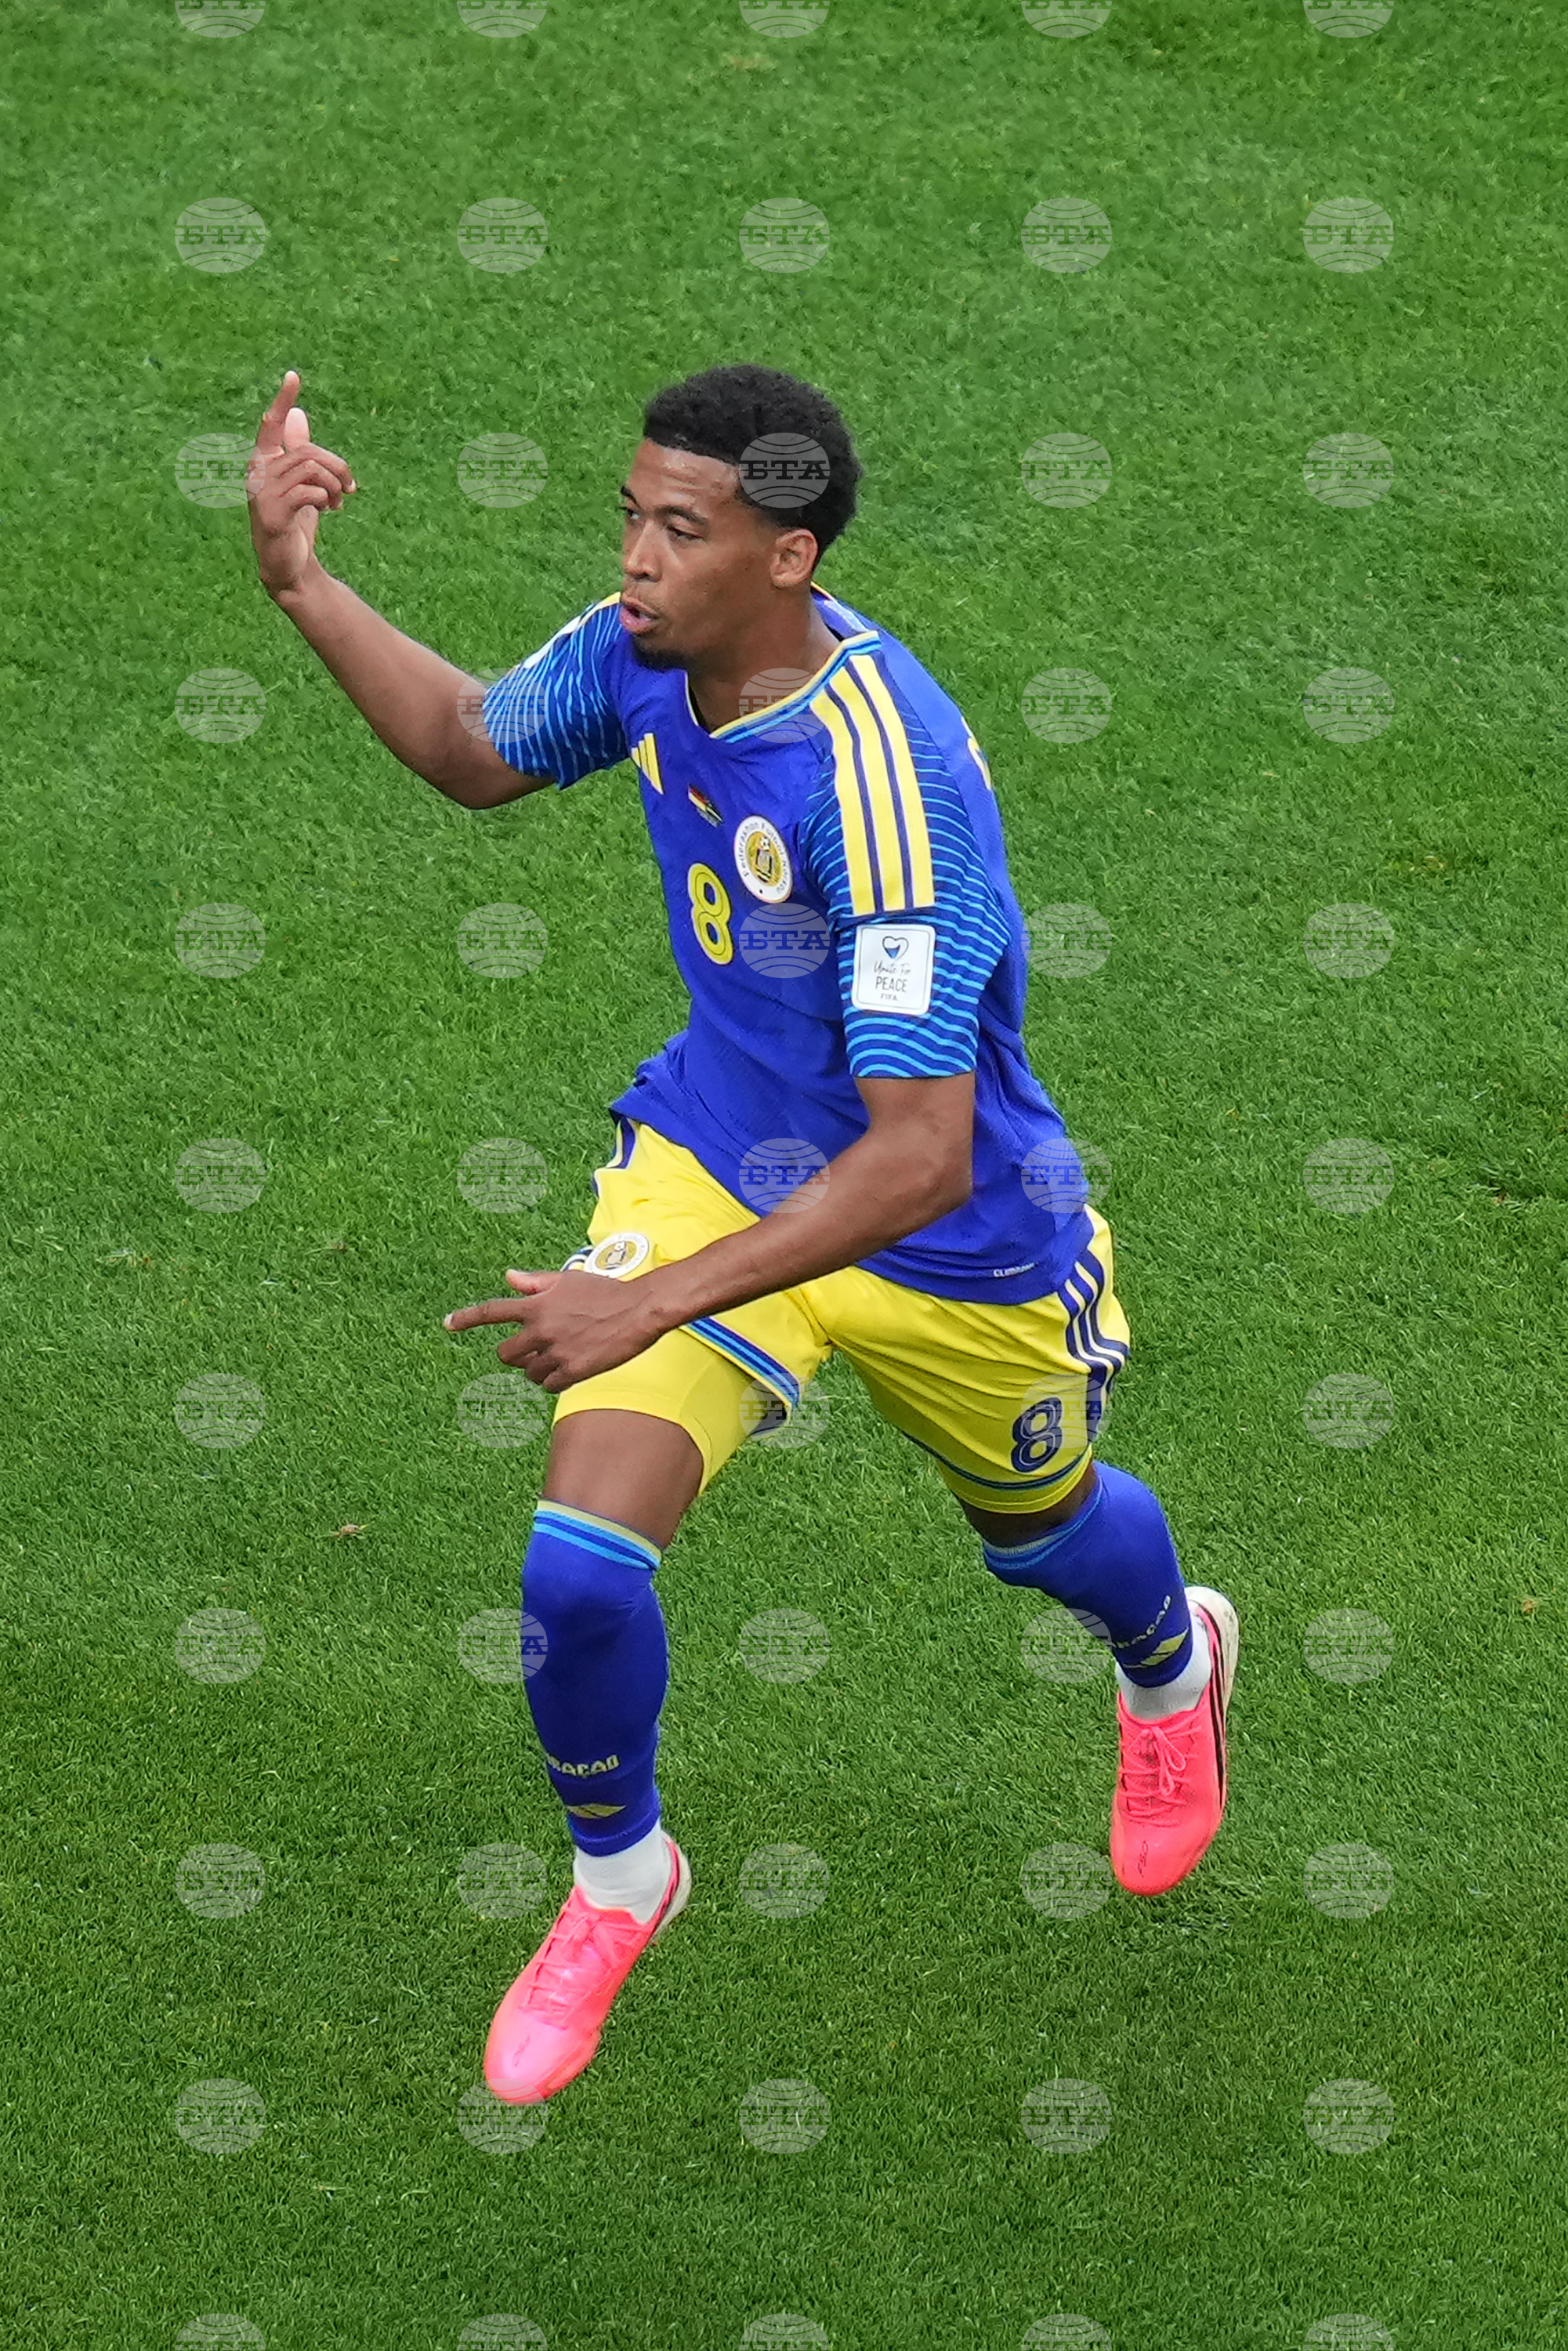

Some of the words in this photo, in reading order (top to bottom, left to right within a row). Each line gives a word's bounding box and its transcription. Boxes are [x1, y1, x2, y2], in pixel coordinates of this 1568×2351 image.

[687, 863, 733, 965] 8
[875, 976, 908, 993] PEACE
[1011, 1397, 1062, 1473] 8
